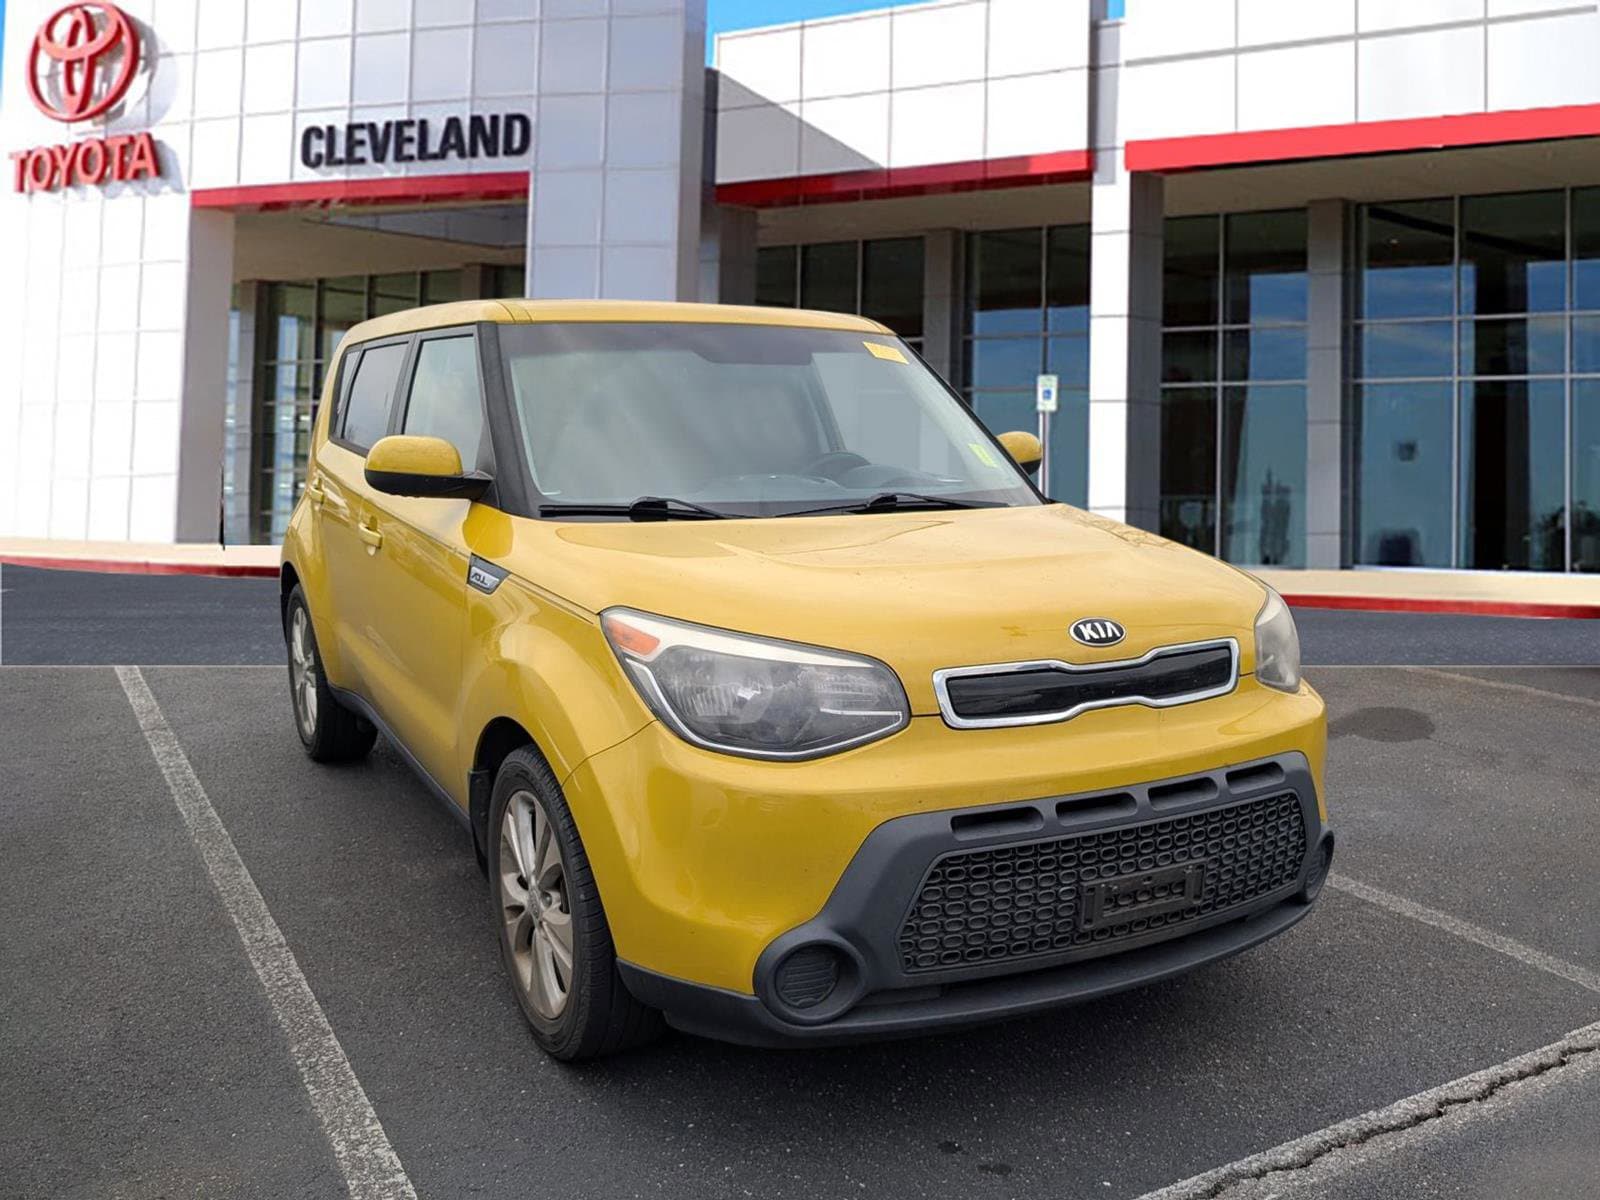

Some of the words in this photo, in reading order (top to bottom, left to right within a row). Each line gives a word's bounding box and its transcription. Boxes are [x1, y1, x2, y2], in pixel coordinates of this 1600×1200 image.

[9, 132, 160, 193] TOYOTA
[301, 114, 531, 168] CLEVELAND
[1077, 621, 1121, 640] KIA
